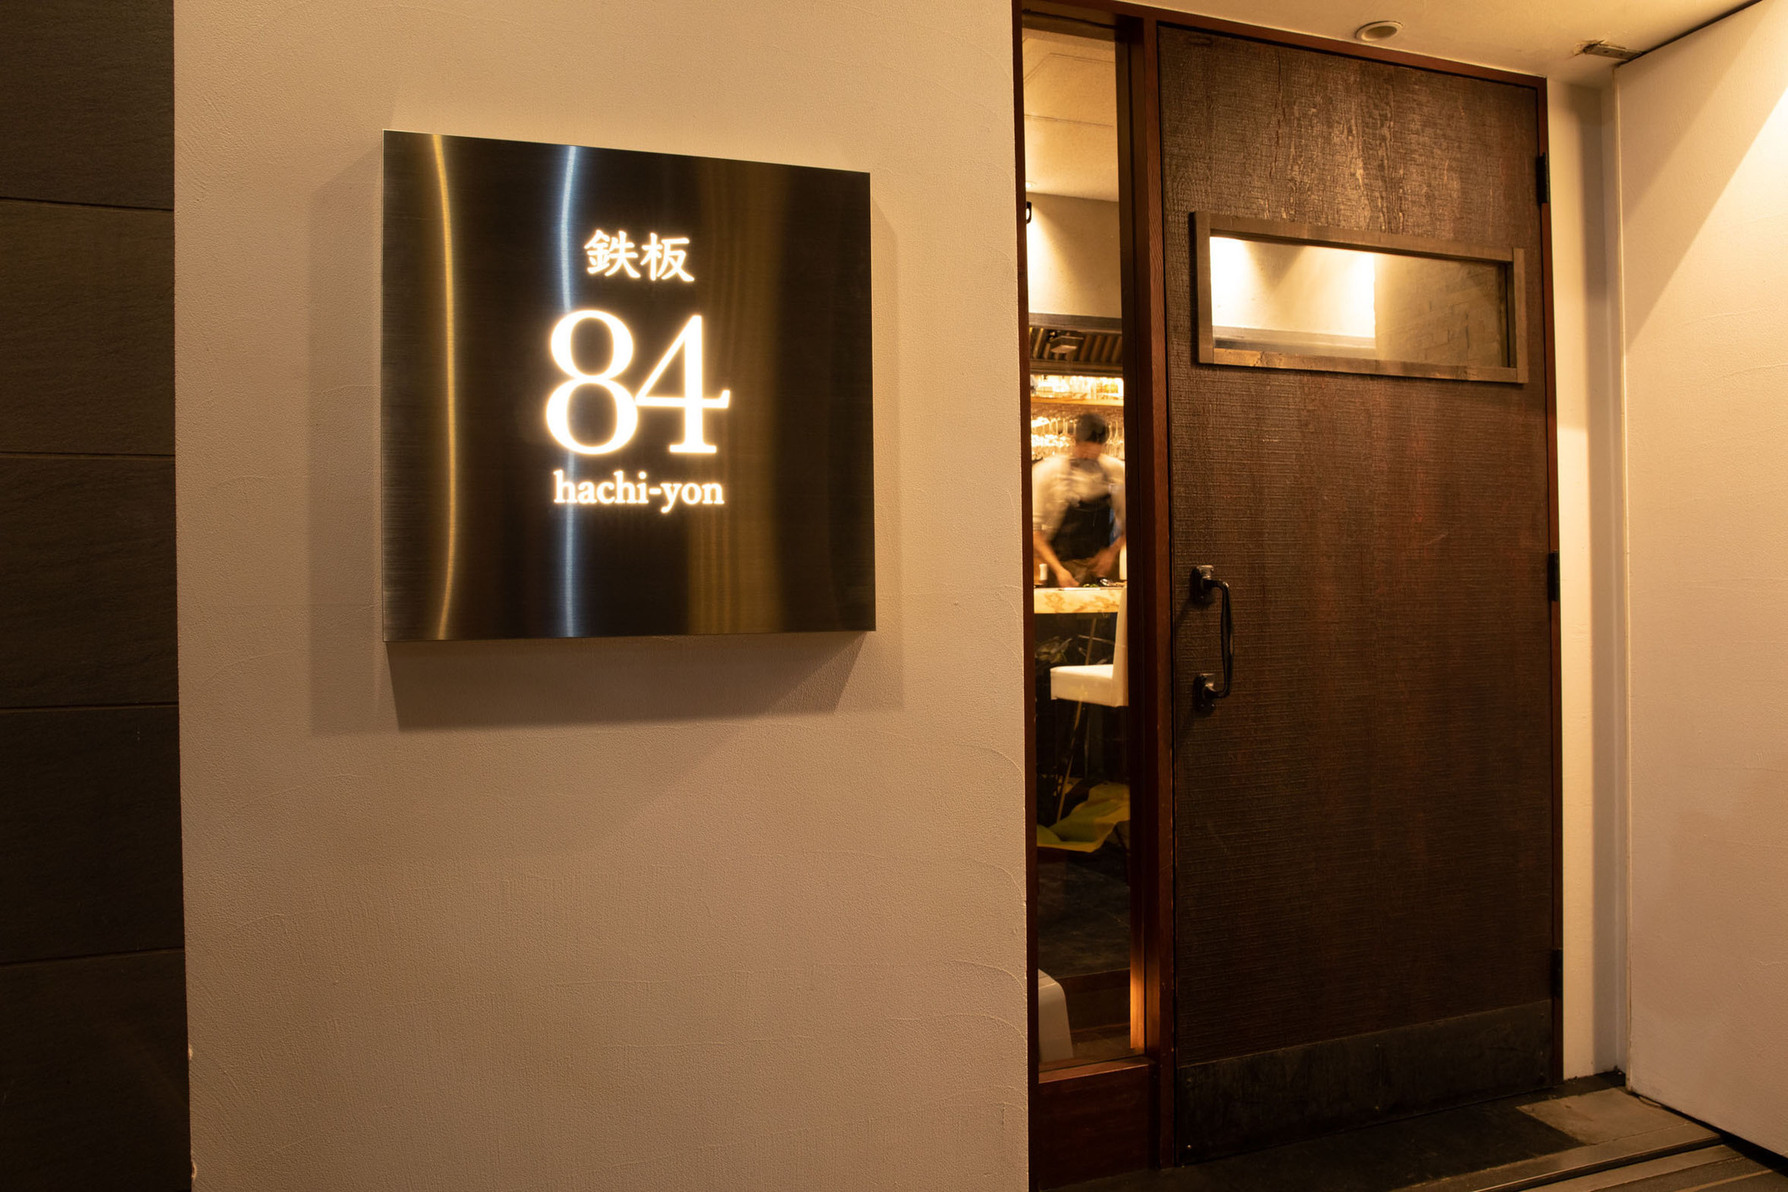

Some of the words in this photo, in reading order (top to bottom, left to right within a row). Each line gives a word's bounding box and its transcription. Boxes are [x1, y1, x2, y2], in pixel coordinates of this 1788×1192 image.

[584, 229, 695, 282] 鉄板
[545, 309, 731, 456] 84
[553, 469, 725, 514] hachi-yon
